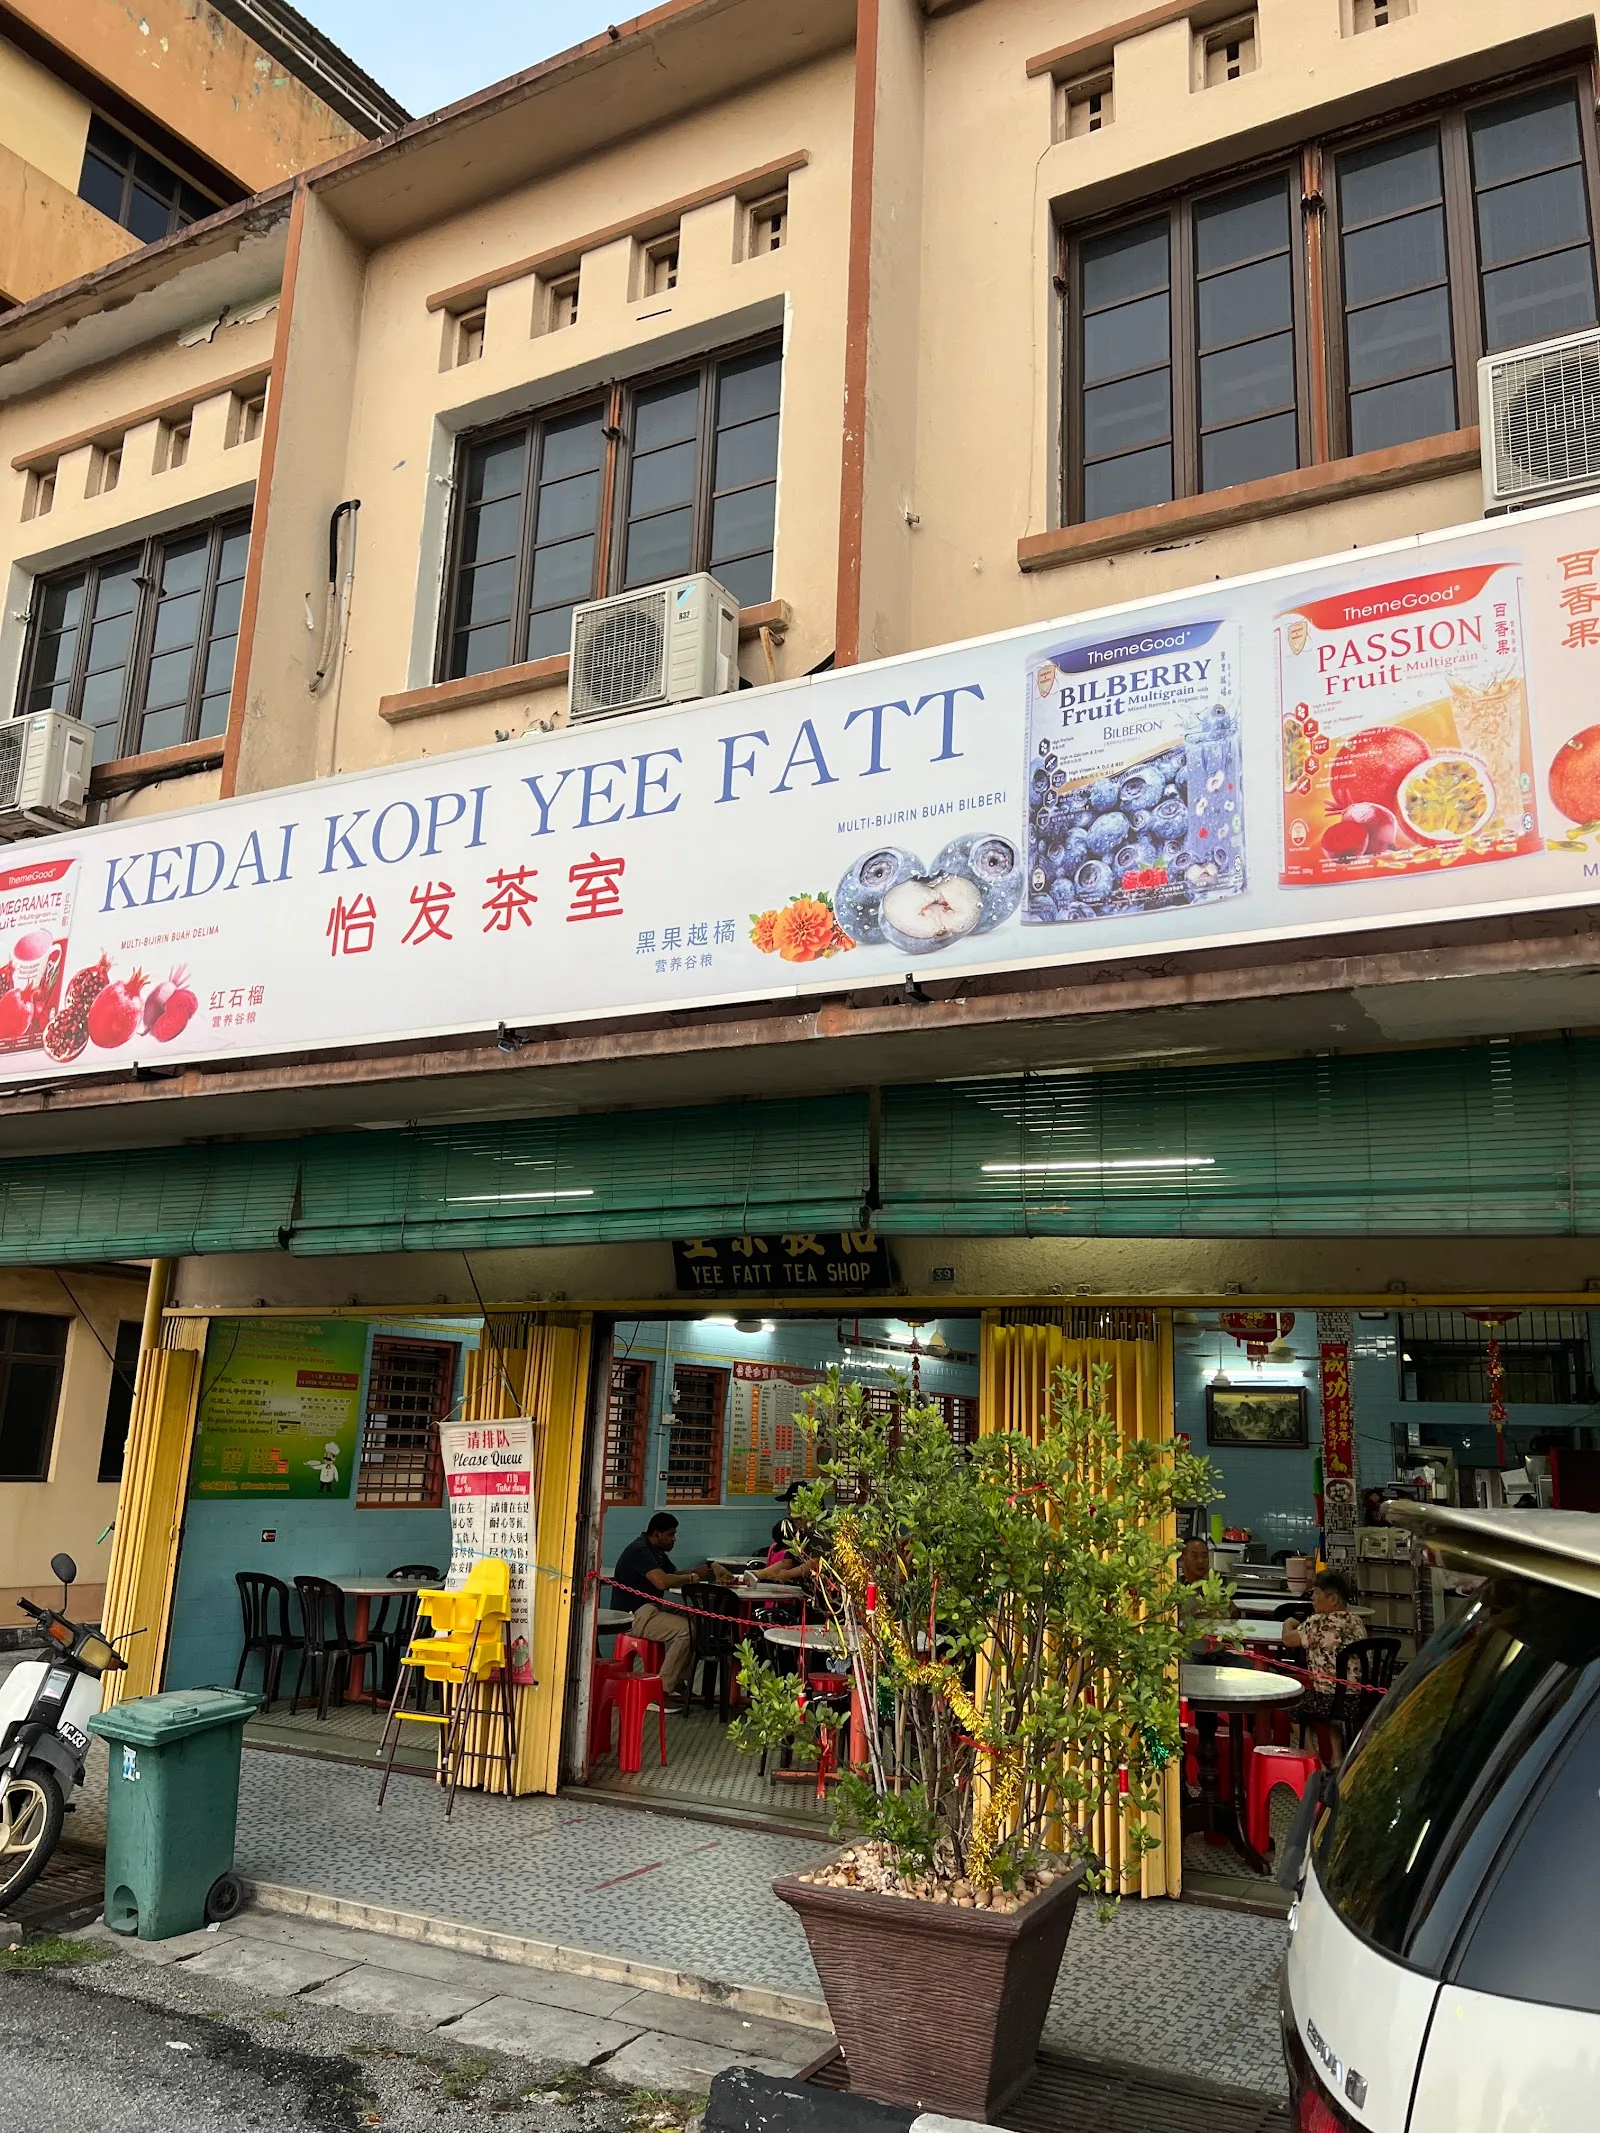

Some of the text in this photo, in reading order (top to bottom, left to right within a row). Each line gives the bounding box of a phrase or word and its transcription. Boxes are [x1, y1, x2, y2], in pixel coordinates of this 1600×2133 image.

[1493, 602, 1510, 656] 百香果
[1316, 615, 1483, 674] PASSION
[1059, 658, 1212, 710] BILBERRY
[1324, 664, 1403, 697] Fruit
[1406, 652, 1479, 673] Multigrain
[1061, 696, 1126, 727] Fruit
[1127, 685, 1195, 707] Multigrain
[98, 822, 299, 913] KEDAI
[318, 784, 491, 874] KOPI
[521, 747, 683, 837] YEE
[713, 683, 985, 804] FATT
[837, 791, 1007, 834] MULTI-BIJIRIN BUAH BILBERI
[1583, 862, 1599, 878] M
[326, 852, 626, 957] 怡发茶室
[121, 925, 220, 950] MULTI-BIJIRIN BUAH DELIMA
[635, 918, 736, 954] 黑果越橘
[654, 953, 713, 974] 营养谷粮
[208, 984, 265, 1011] 红石榴
[211, 1011, 258, 1028] 营养谷粮
[692, 1262, 871, 1285] YEE FATT TEA SHOP
[467, 1429, 510, 1449] 请排队
[453, 1450, 523, 1469] Please Queue
[496, 1483, 527, 1494] Take Away
[59, 1722, 87, 1749] ACJ33
